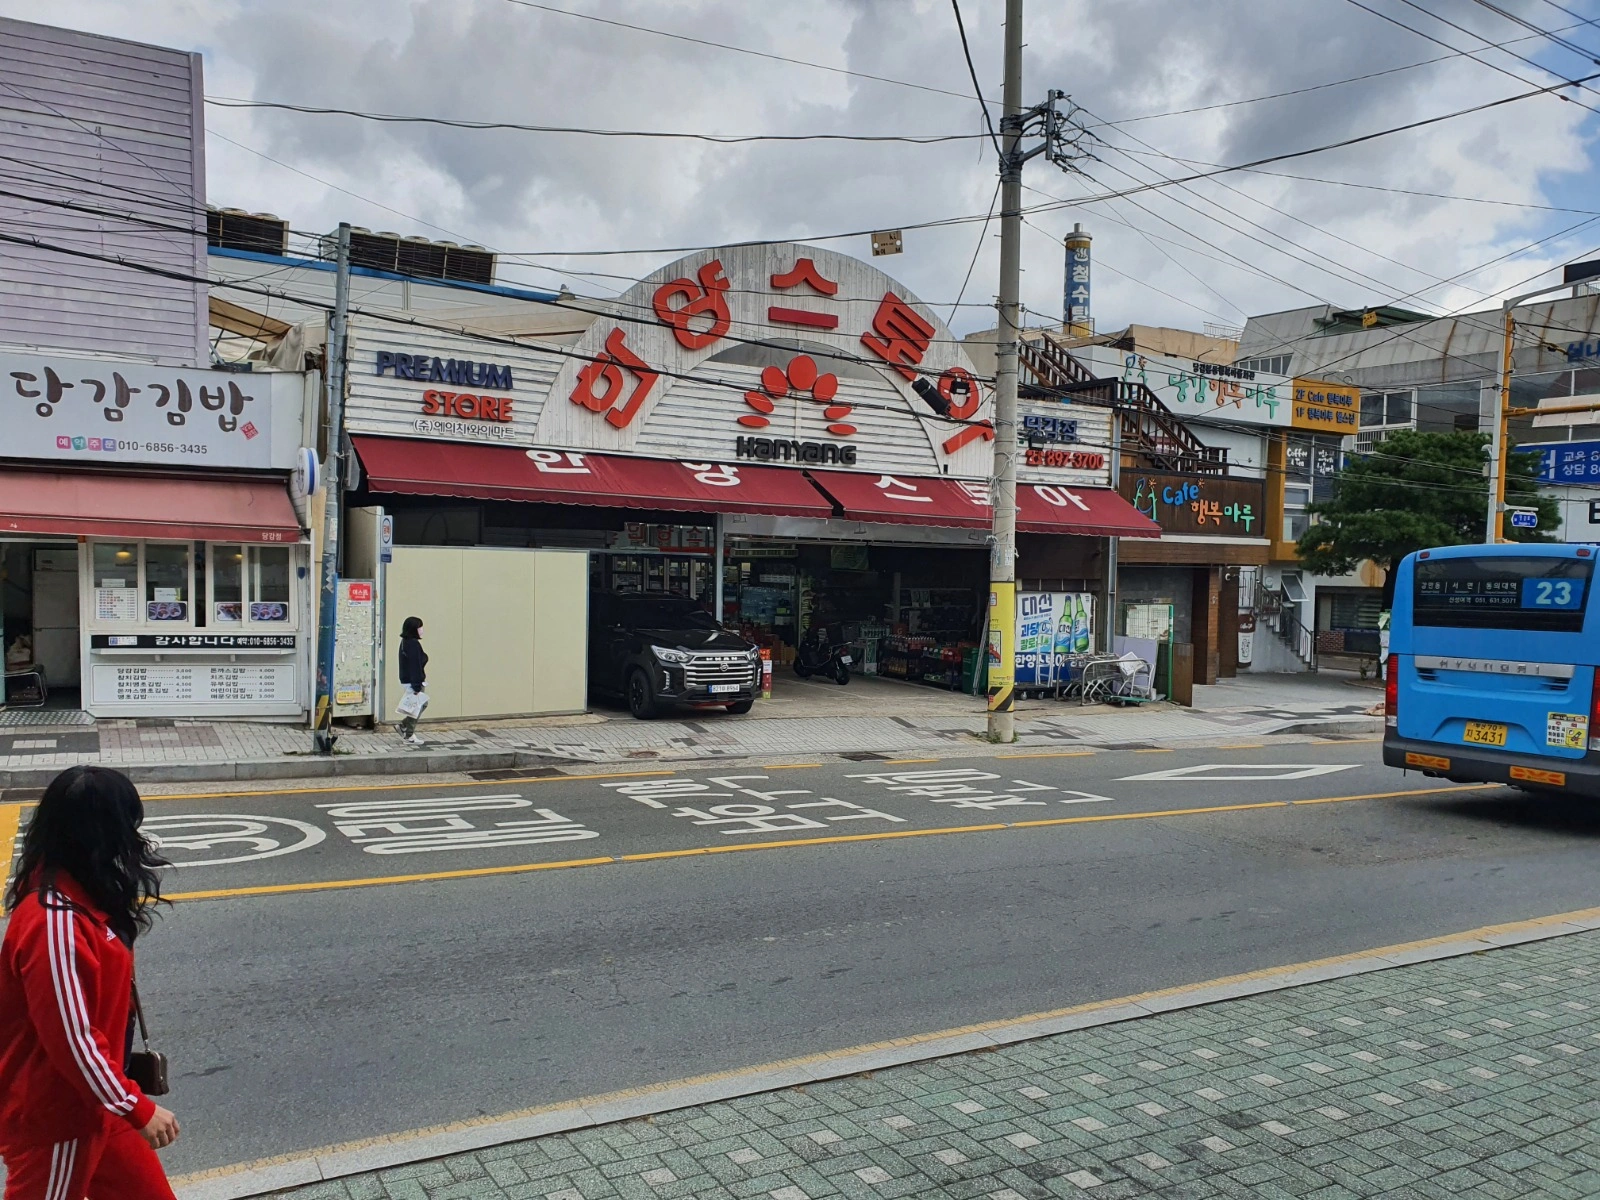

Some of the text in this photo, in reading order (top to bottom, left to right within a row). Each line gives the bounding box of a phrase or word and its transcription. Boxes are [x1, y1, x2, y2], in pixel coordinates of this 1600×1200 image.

[376, 350, 514, 390] PREMIUM
[9, 366, 254, 433] 당감김밥
[421, 389, 513, 422] STORE
[57, 436, 208, 454] 예약주문 010-6856-3435
[1044, 450, 1105, 470] 897-3700
[1562, 464, 1586, 476] 상담
[1563, 451, 1586, 466] 교육
[1163, 481, 1200, 506] Cafe
[1191, 499, 1256, 533] 행복마루
[1022, 592, 1053, 617] 대선
[1535, 581, 1572, 605] 23
[155, 636, 235, 646] 감사합니다
[315, 794, 600, 856] 어린이
